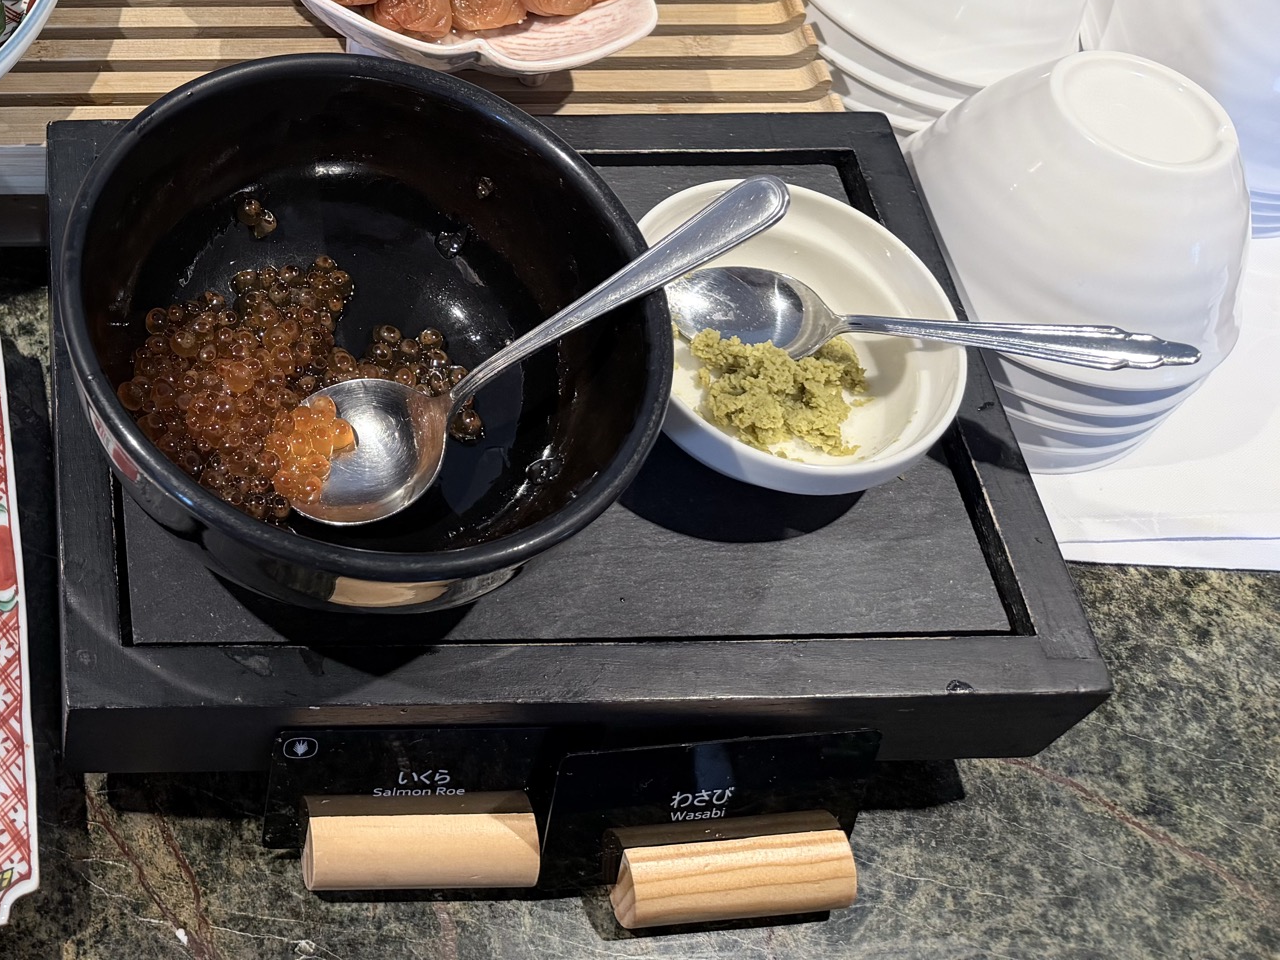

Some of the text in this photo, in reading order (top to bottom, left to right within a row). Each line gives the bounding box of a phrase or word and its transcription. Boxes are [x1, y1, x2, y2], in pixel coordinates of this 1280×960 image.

[398, 769, 451, 785] いくら
[373, 787, 466, 797] Salmon Roe
[670, 786, 735, 809] わさび
[670, 808, 725, 822] Wasabi
